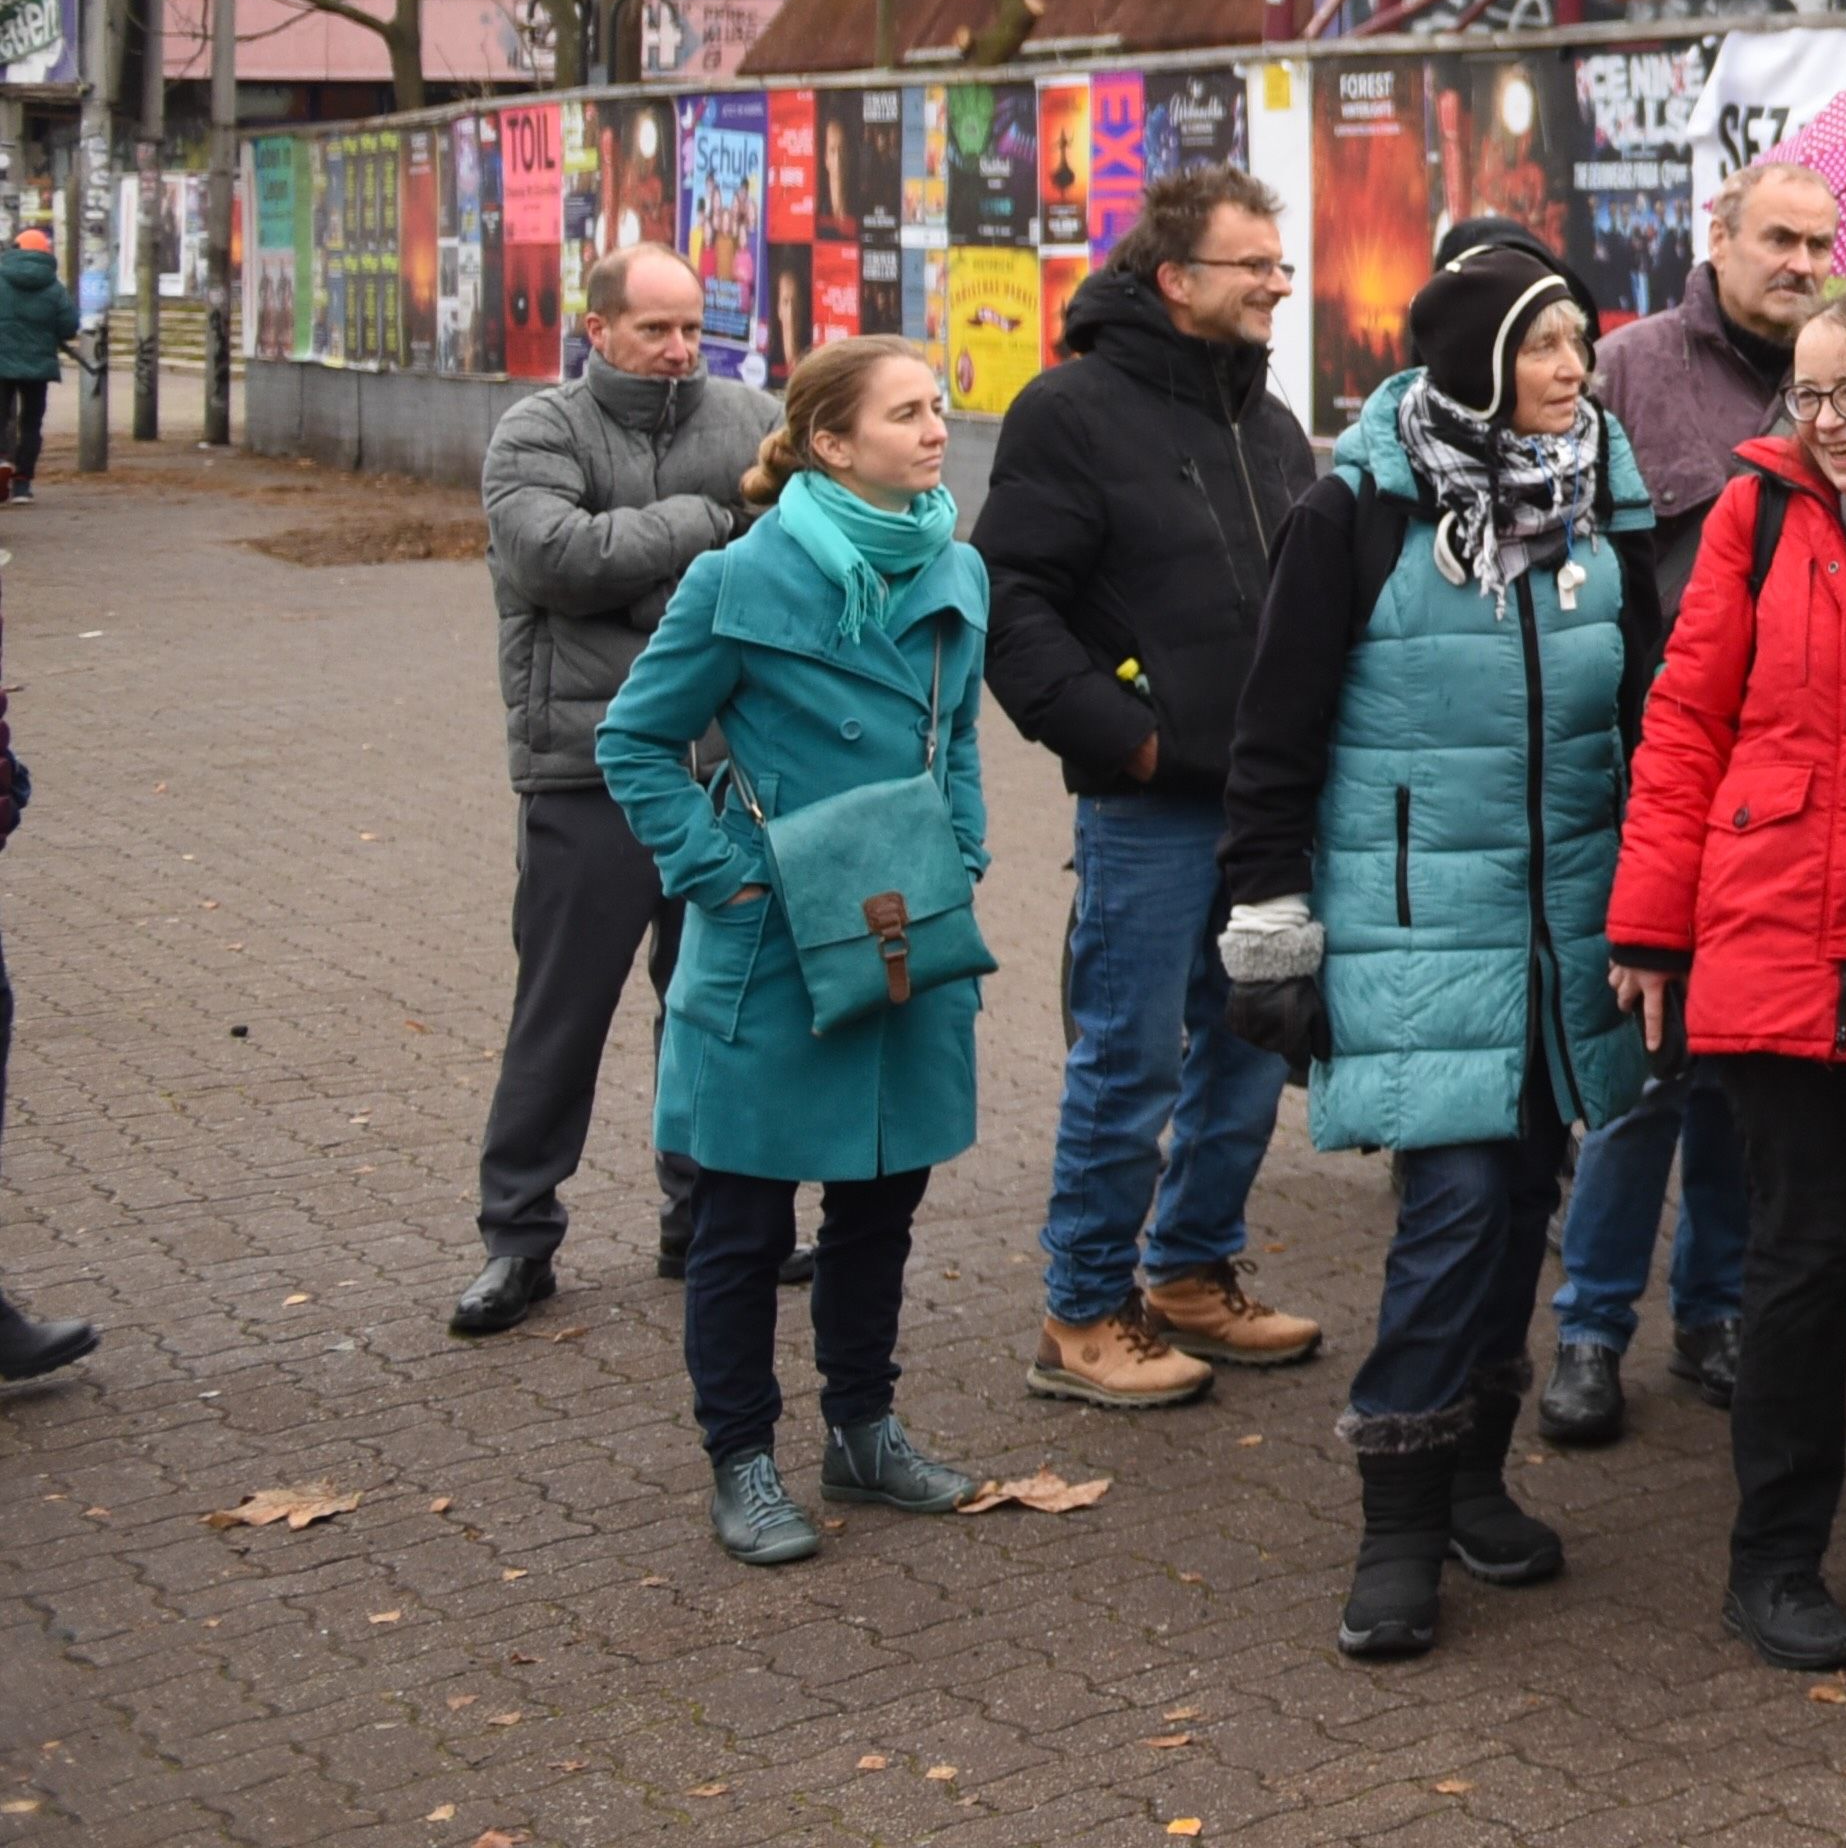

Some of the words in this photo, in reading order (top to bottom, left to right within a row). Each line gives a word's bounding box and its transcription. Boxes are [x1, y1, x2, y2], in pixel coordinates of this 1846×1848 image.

[1340, 71, 1394, 99] FOREST
[507, 112, 556, 173] TOIL
[697, 135, 759, 173] Schule
